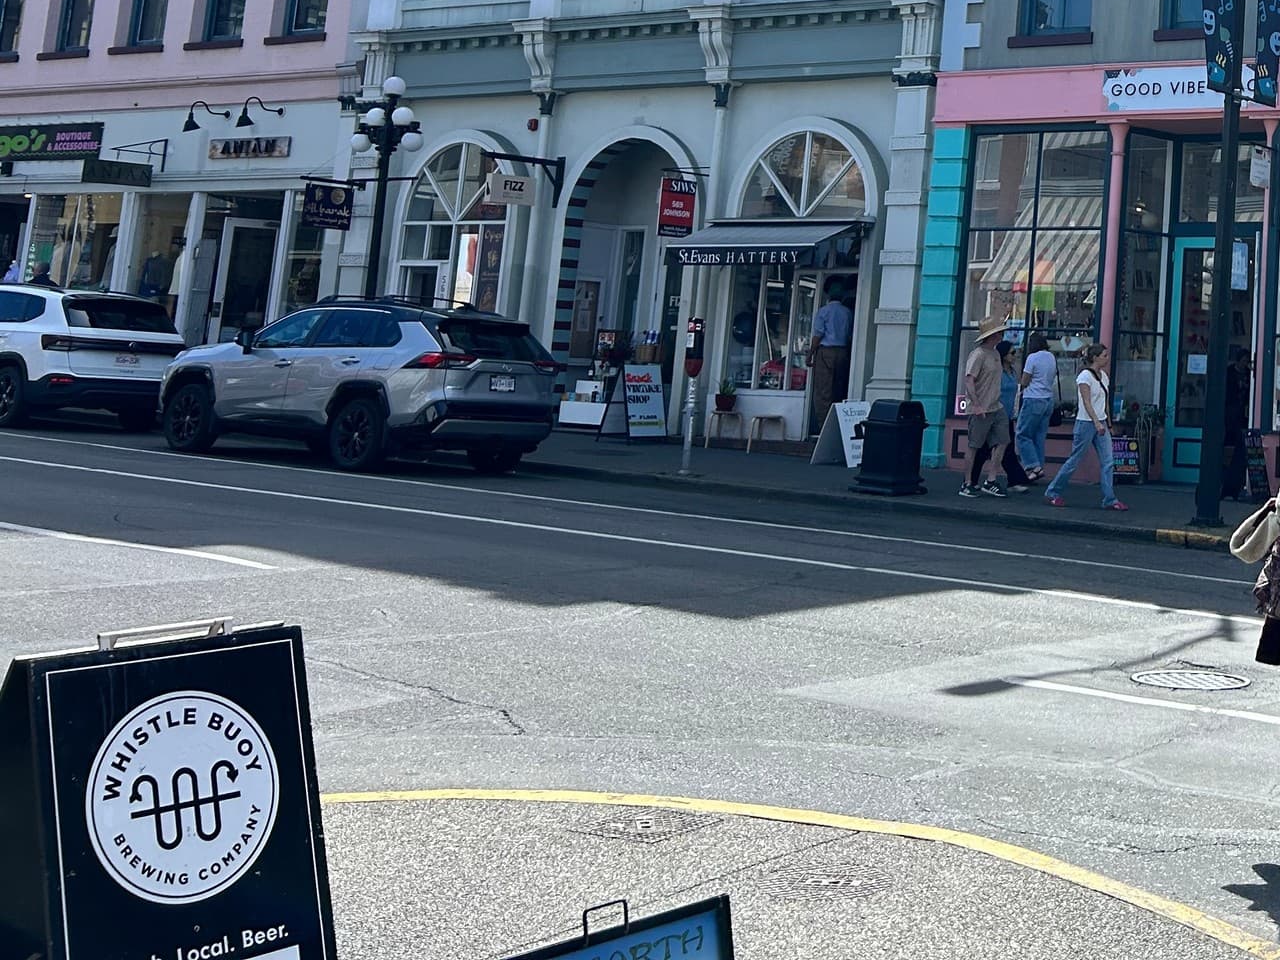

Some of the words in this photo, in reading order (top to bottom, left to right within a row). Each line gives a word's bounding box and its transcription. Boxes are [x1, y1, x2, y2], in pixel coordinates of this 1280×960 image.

[1111, 82, 1161, 96] GOOD
[1170, 80, 1207, 95] VIBE
[56, 131, 93, 141] BOUTIQUE
[53, 141, 98, 151] ACCESSORIES
[503, 180, 525, 192] FIZZ
[663, 208, 690, 218] JOHNSON
[726, 251, 798, 264] HATTERY
[627, 384, 662, 393] VINTAGE
[628, 395, 650, 404] SHOP
[103, 708, 196, 801] WHISTLE
[207, 712, 262, 772] BUOY
[113, 833, 189, 885] BREWING
[198, 804, 261, 881] COMPANY
[241, 924, 289, 948] Beer.
